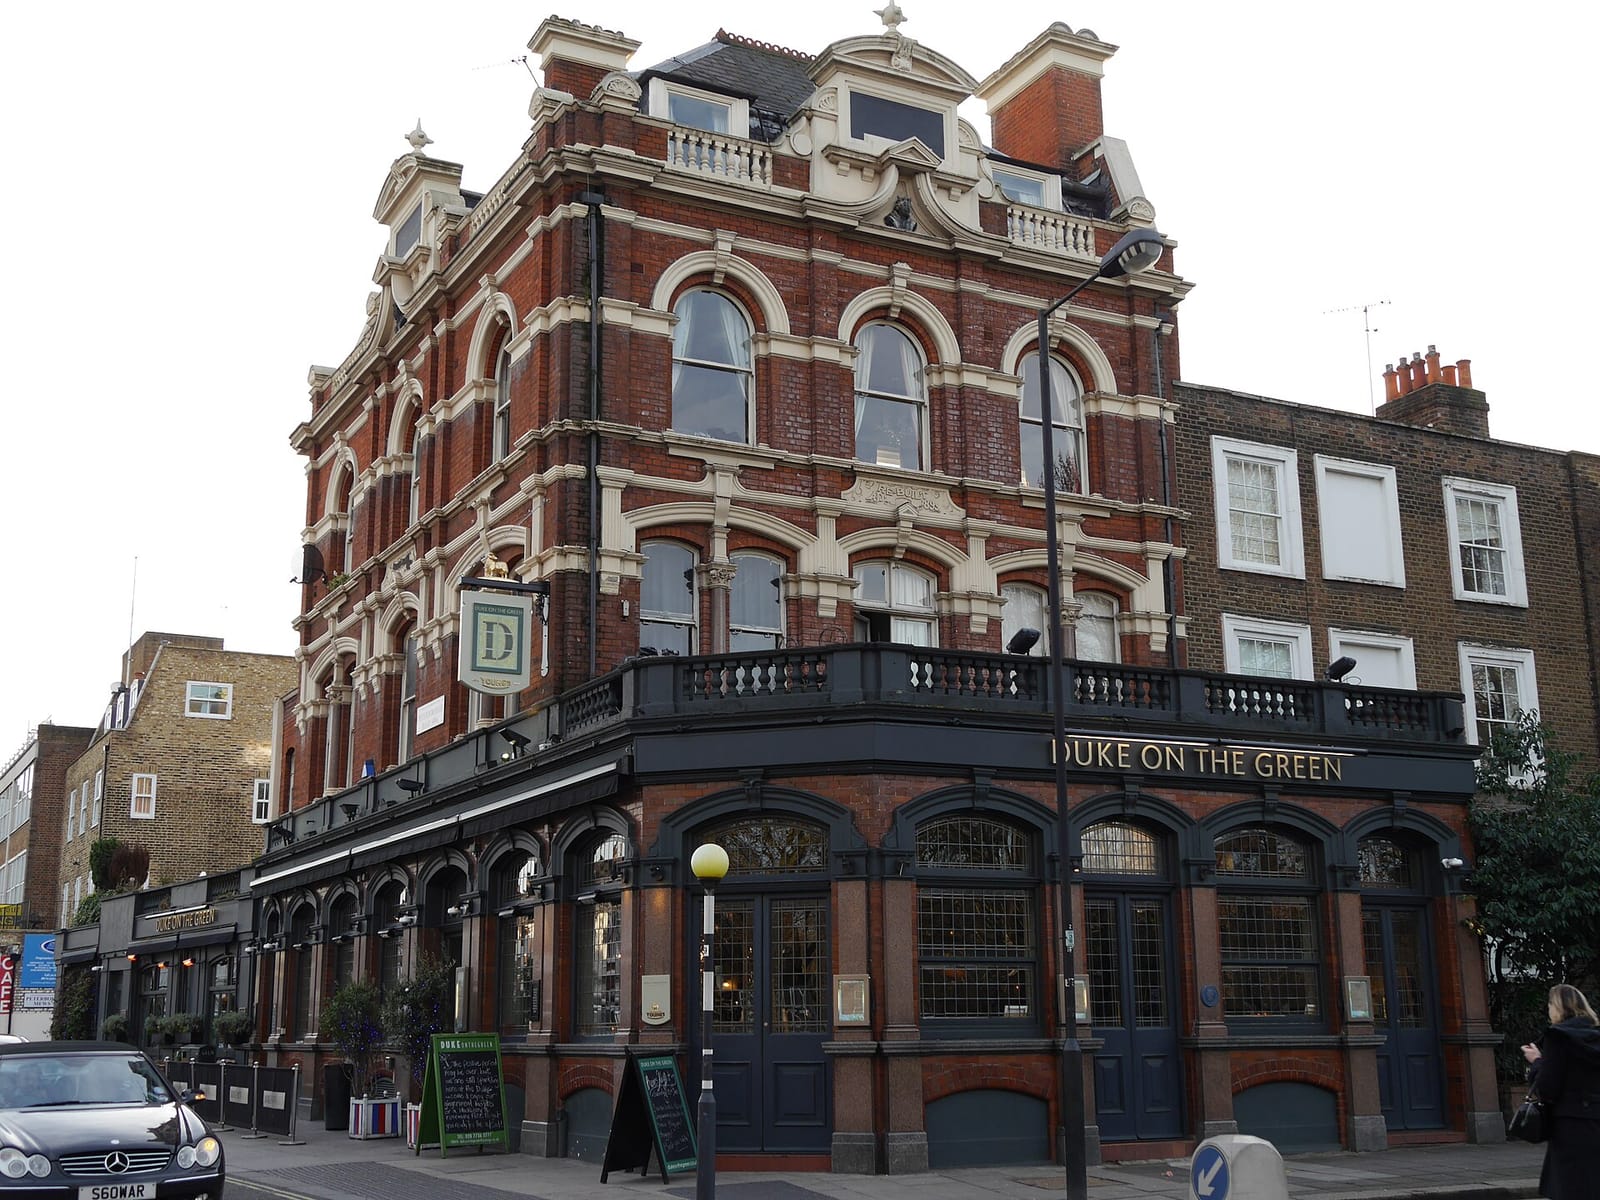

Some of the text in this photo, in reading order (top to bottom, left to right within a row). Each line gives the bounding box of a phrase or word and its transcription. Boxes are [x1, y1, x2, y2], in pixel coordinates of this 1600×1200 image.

[482, 620, 513, 660] D
[1141, 745, 1185, 771] ON
[1193, 748, 1246, 775] THE
[1255, 753, 1342, 781] GREEN
[155, 908, 215, 932] DUKE ON THE GREEN
[0, 957, 14, 1013] CAFE
[440, 1040, 461, 1049] DUKE
